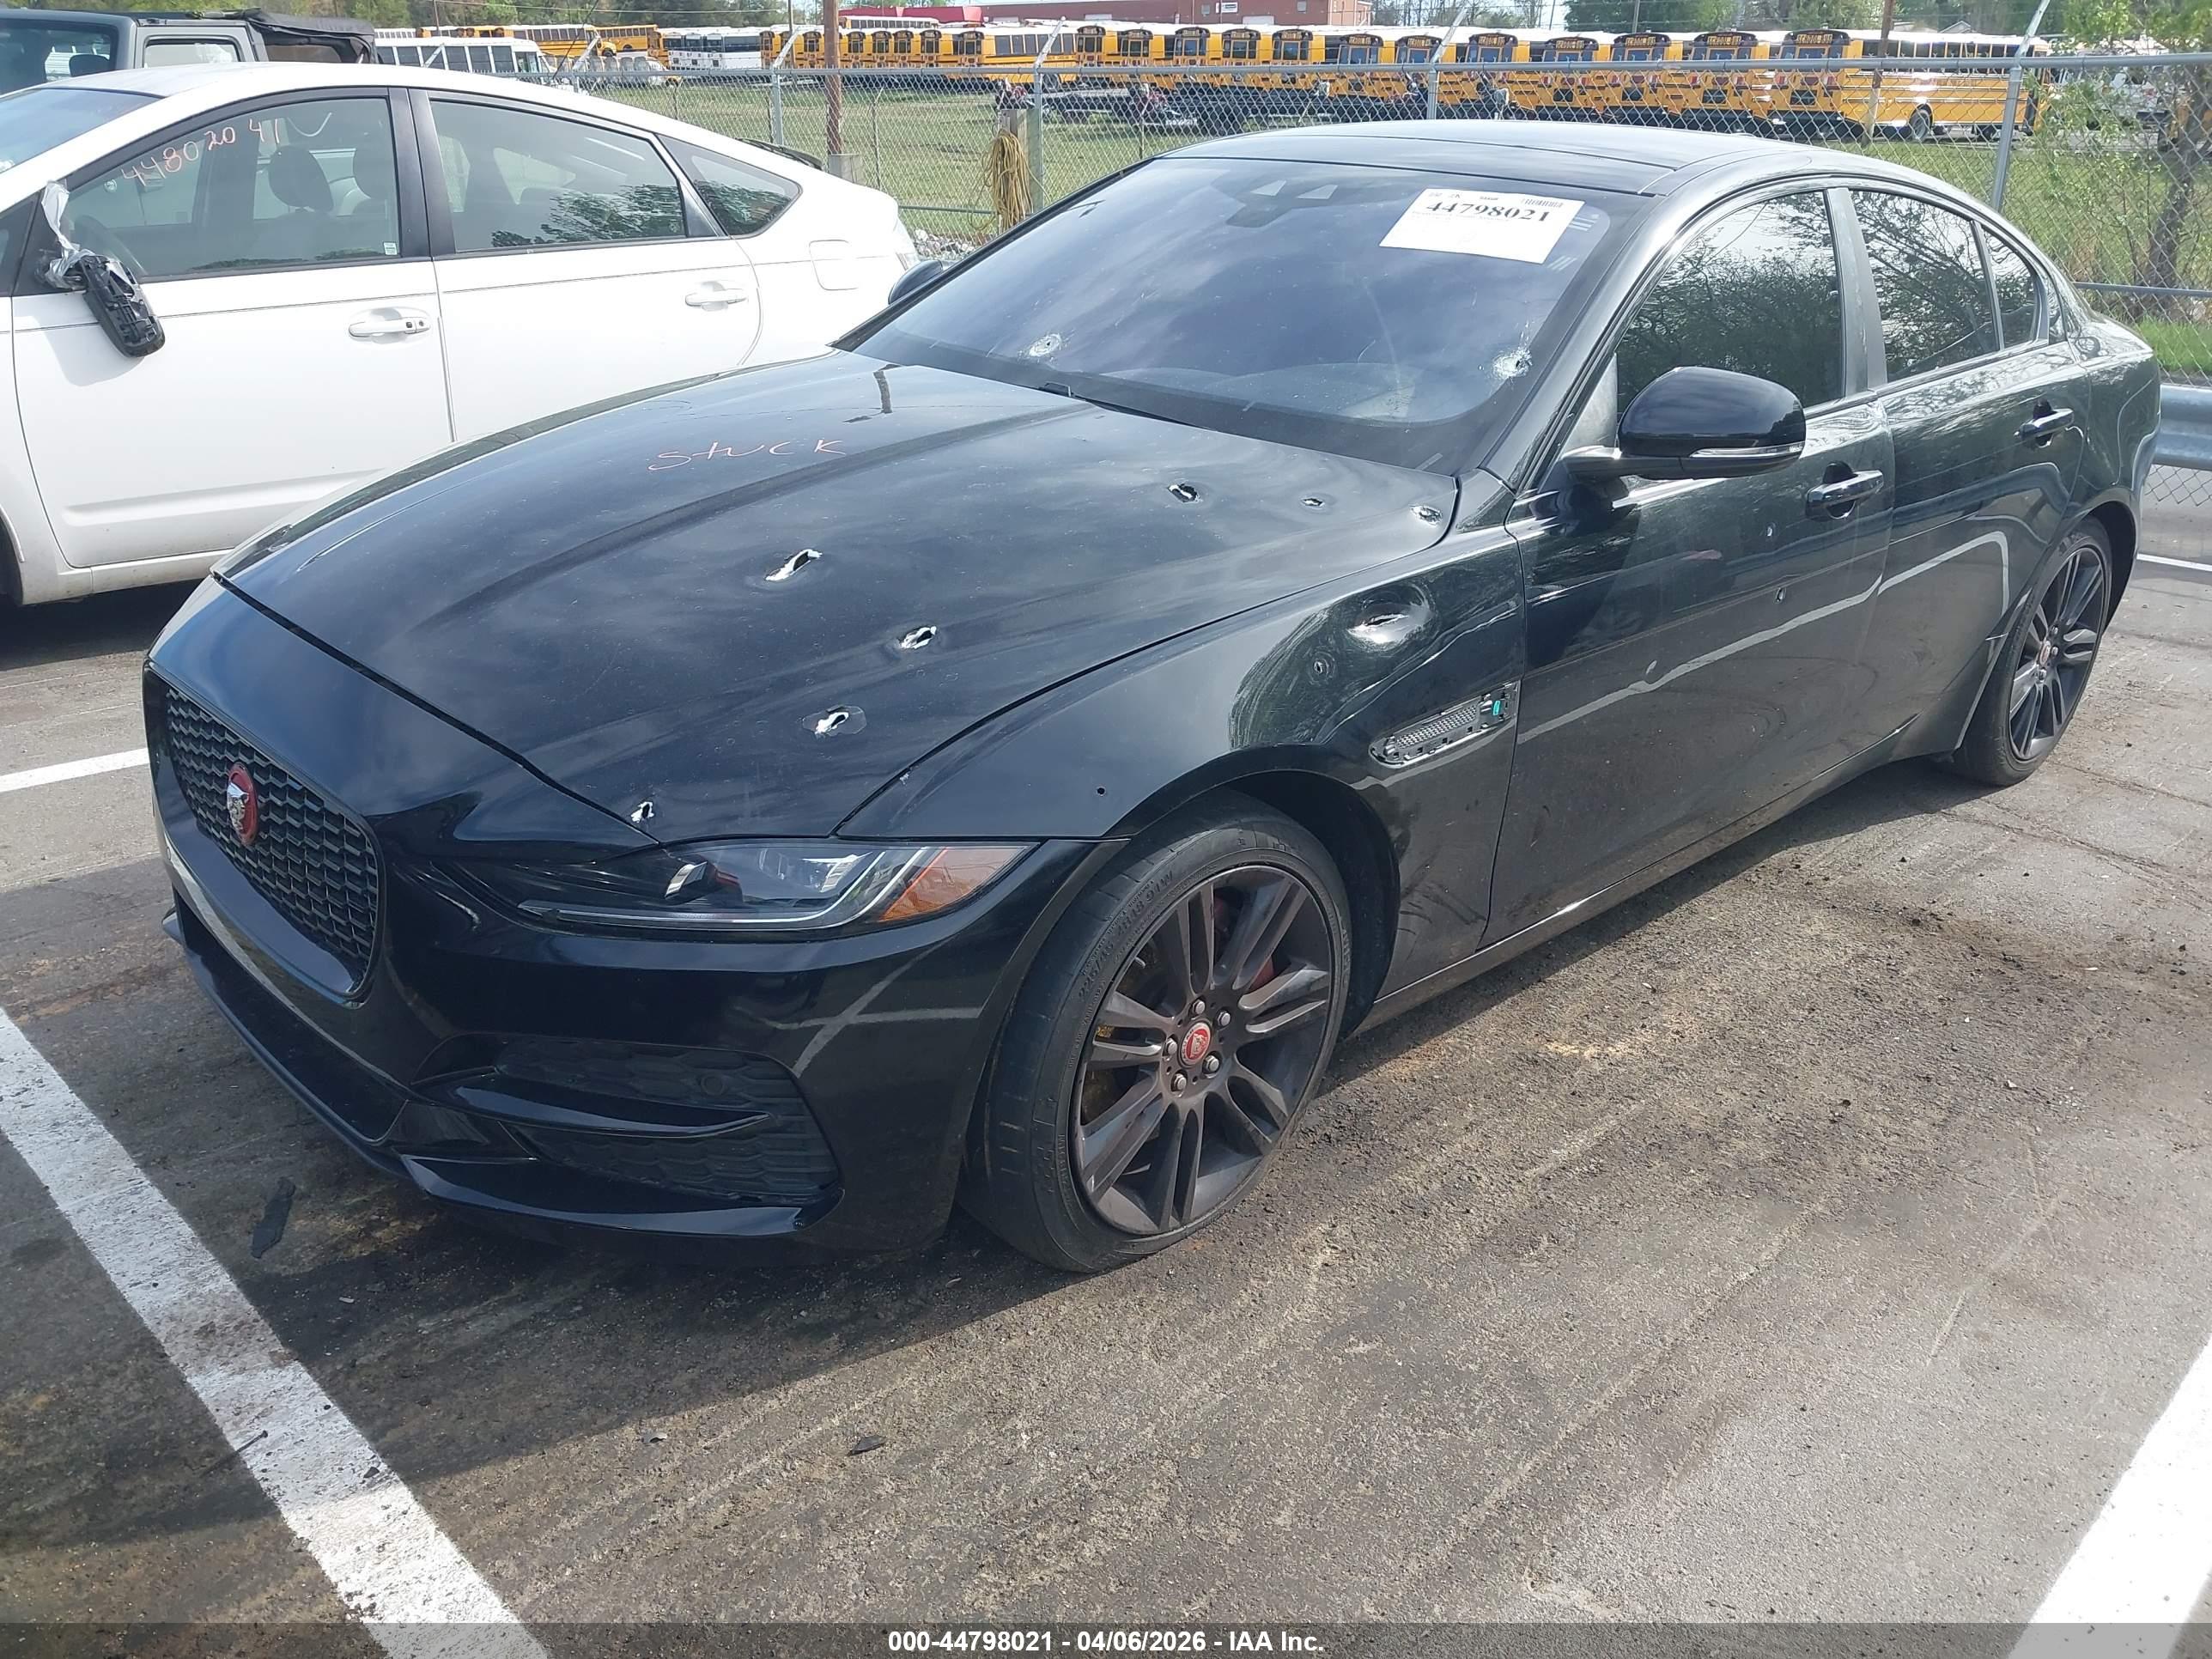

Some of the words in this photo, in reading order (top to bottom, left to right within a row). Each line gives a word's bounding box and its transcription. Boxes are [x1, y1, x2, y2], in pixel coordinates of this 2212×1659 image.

[1797, 33, 1822, 44] SCHOOL
[1823, 33, 1833, 43] BUS
[1425, 201, 1550, 222] 44798021
